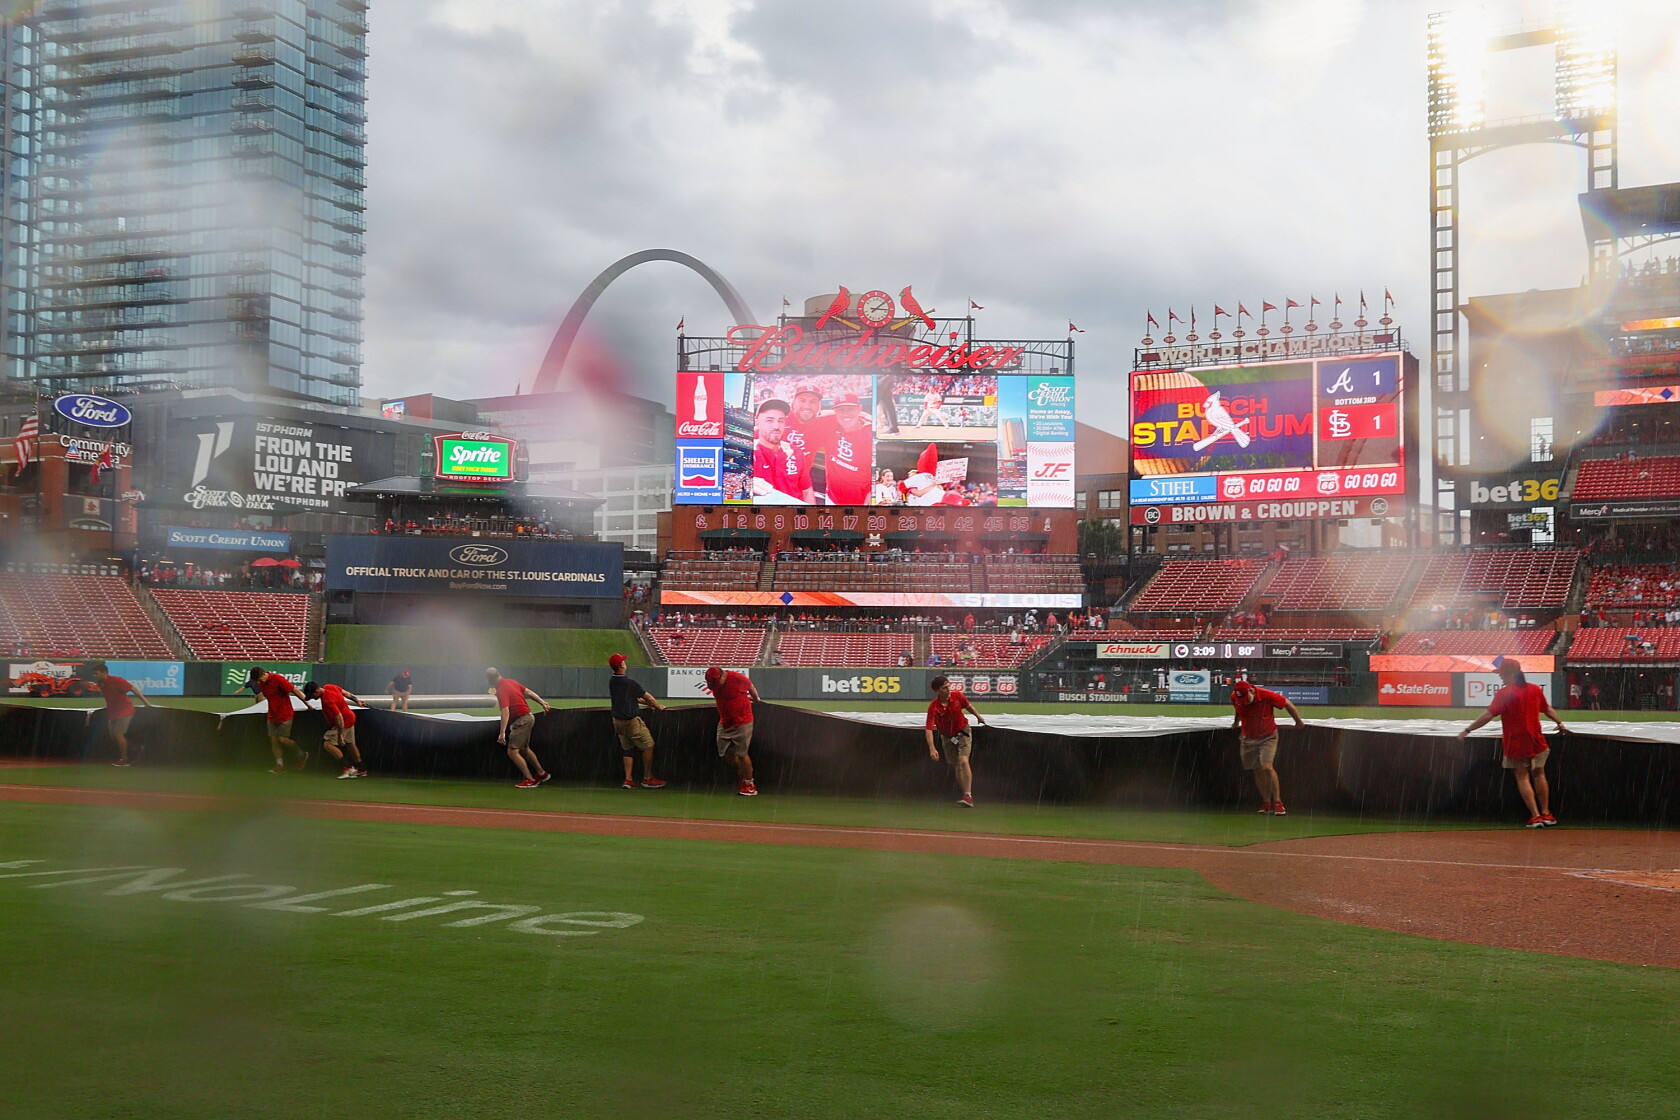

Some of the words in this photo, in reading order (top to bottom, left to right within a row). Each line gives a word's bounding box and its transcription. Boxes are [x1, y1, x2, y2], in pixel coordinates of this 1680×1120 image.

[726, 324, 1026, 373] Budweiser
[1158, 345, 1236, 364] WORLD
[1240, 333, 1375, 357] CHAMPIONS
[1373, 370, 1380, 385] 1
[1335, 397, 1362, 406] BOTTOM
[1363, 396, 1377, 404] 3RD
[71, 397, 117, 422] Ford
[273, 423, 313, 437] PHORM
[678, 421, 722, 436] Coca-Cola
[1373, 415, 1380, 430] 1
[461, 431, 491, 440] Coca-Cola
[255, 435, 311, 458] FROM
[315, 442, 353, 463] THE
[449, 446, 501, 465] Sprite
[254, 453, 293, 474] LOU
[297, 458, 338, 479] AND
[253, 471, 317, 495] WE'RE
[1150, 480, 1199, 496] STIFEL
[1250, 479, 1265, 493] GO
[1267, 478, 1283, 492] GO
[1284, 477, 1300, 491] GO
[1321, 481, 1335, 490] 66
[1344, 475, 1361, 489] GO
[1362, 474, 1379, 488] GO
[1381, 472, 1397, 487] GO
[193, 485, 229, 497] SCOTT
[1227, 486, 1241, 494] 66
[1470, 478, 1559, 504] bet36
[192, 499, 228, 509] UNION
[246, 494, 271, 503] MVP
[246, 501, 276, 510] DECK
[1374, 502, 1385, 510] BC
[1148, 511, 1158, 519] BC
[1172, 505, 1236, 521] BROWN
[1241, 507, 1252, 519] &
[1257, 500, 1355, 518] CROUPPEN
[1507, 513, 1548, 523] bet365
[1580, 508, 1602, 516] Mercy
[722, 514, 729, 529] 1
[737, 514, 747, 529] 2
[755, 515, 766, 529] 6
[775, 515, 785, 529] 9
[794, 515, 809, 529] 10
[818, 515, 834, 529] 14
[843, 515, 859, 530] 17
[867, 515, 887, 530] 20
[898, 516, 917, 530] 23
[925, 516, 945, 531] 24
[954, 516, 974, 531] 42
[983, 516, 1003, 531] 45
[1010, 516, 1029, 531] 85
[171, 532, 207, 543] SCOTT
[208, 533, 248, 545] CREDIT
[250, 536, 286, 548] UNION
[460, 546, 498, 563] Ford
[346, 566, 392, 577] OFFICIAL
[392, 567, 426, 578] TRUCK
[427, 568, 449, 578] AND
[450, 569, 470, 579] CAR
[472, 570, 485, 579] OF
[487, 570, 506, 580] THE
[507, 571, 521, 580] ST.
[522, 571, 551, 581] LOUIS
[552, 572, 606, 583] CARDINALS
[1102, 645, 1163, 654] Schnucks
[1193, 646, 1216, 656] 3:09
[1238, 646, 1256, 656] 80°
[1272, 648, 1292, 657] Mercy
[822, 675, 901, 694] bet365
[1180, 674, 1200, 684] Ford
[1059, 692, 1087, 701] BUSCH
[1089, 693, 1128, 702] STADIUM
